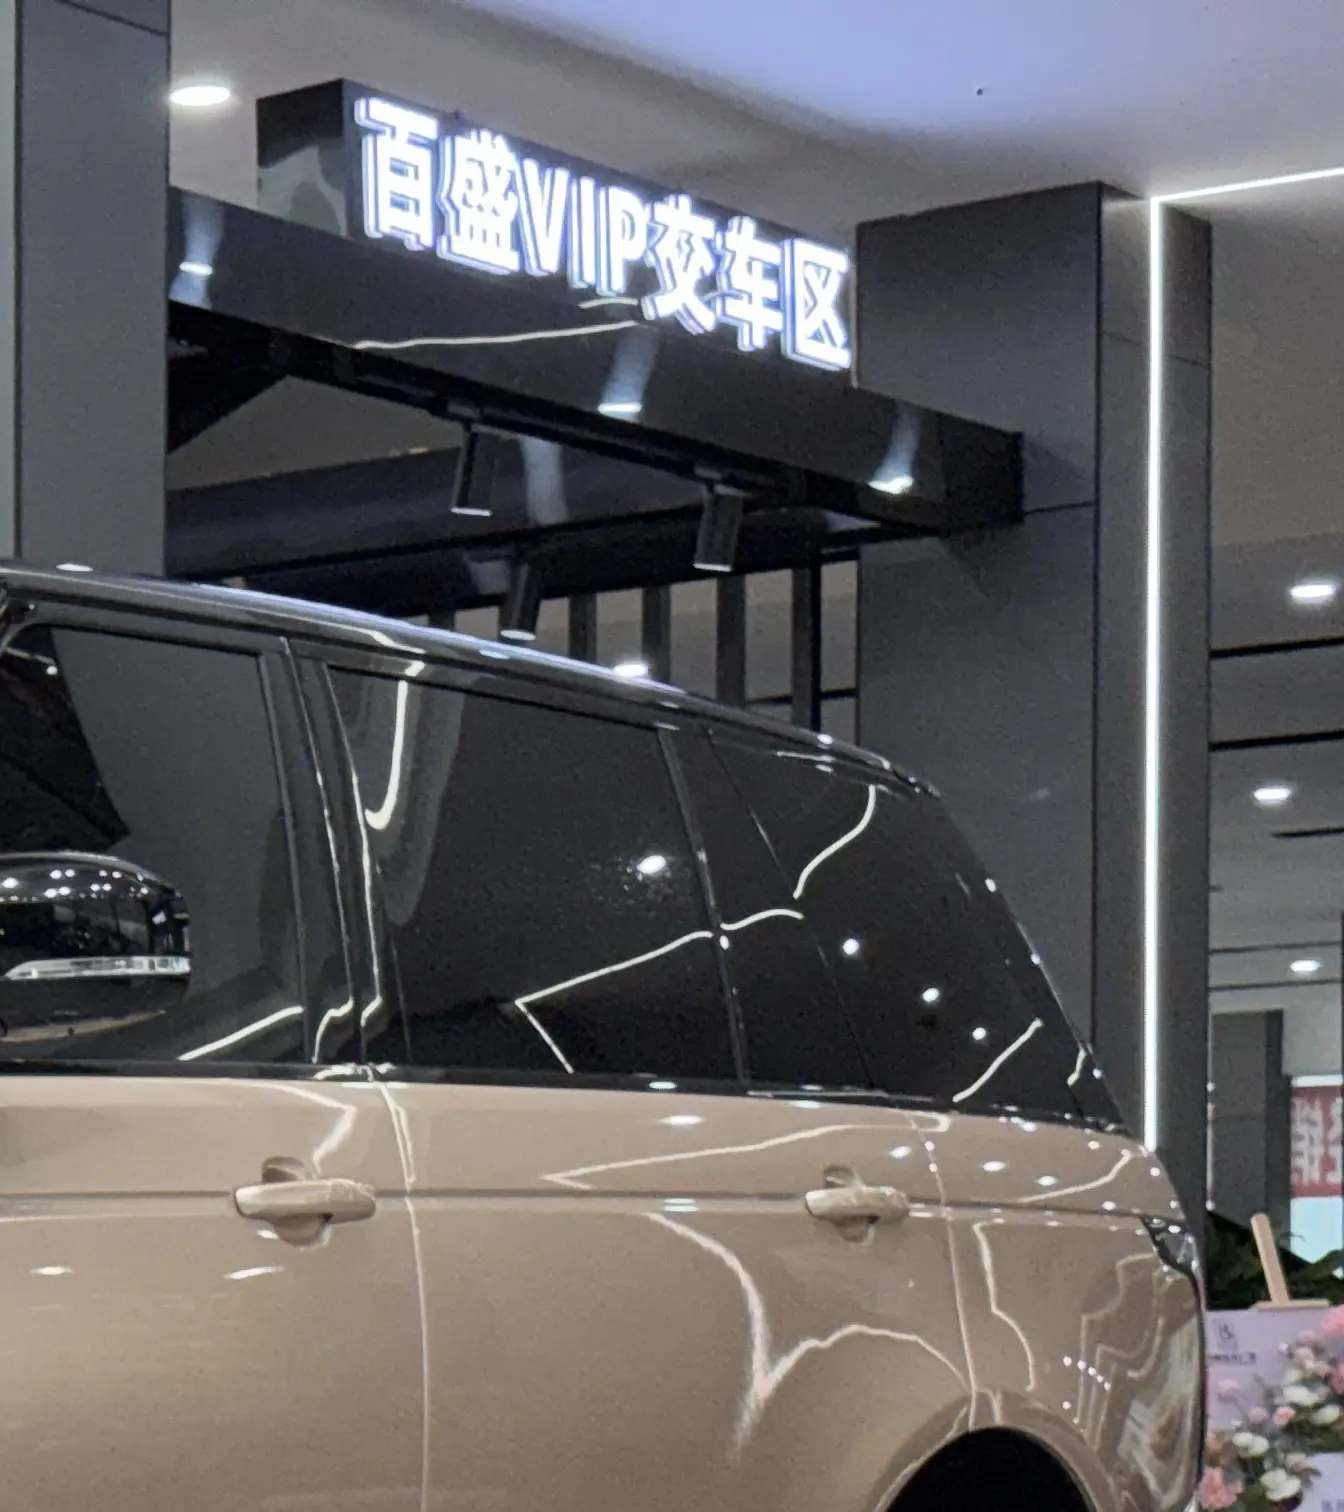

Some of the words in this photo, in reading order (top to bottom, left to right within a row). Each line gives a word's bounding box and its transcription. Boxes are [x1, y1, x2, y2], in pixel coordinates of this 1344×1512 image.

[355, 97, 852, 370] 百盛VIP交车区
